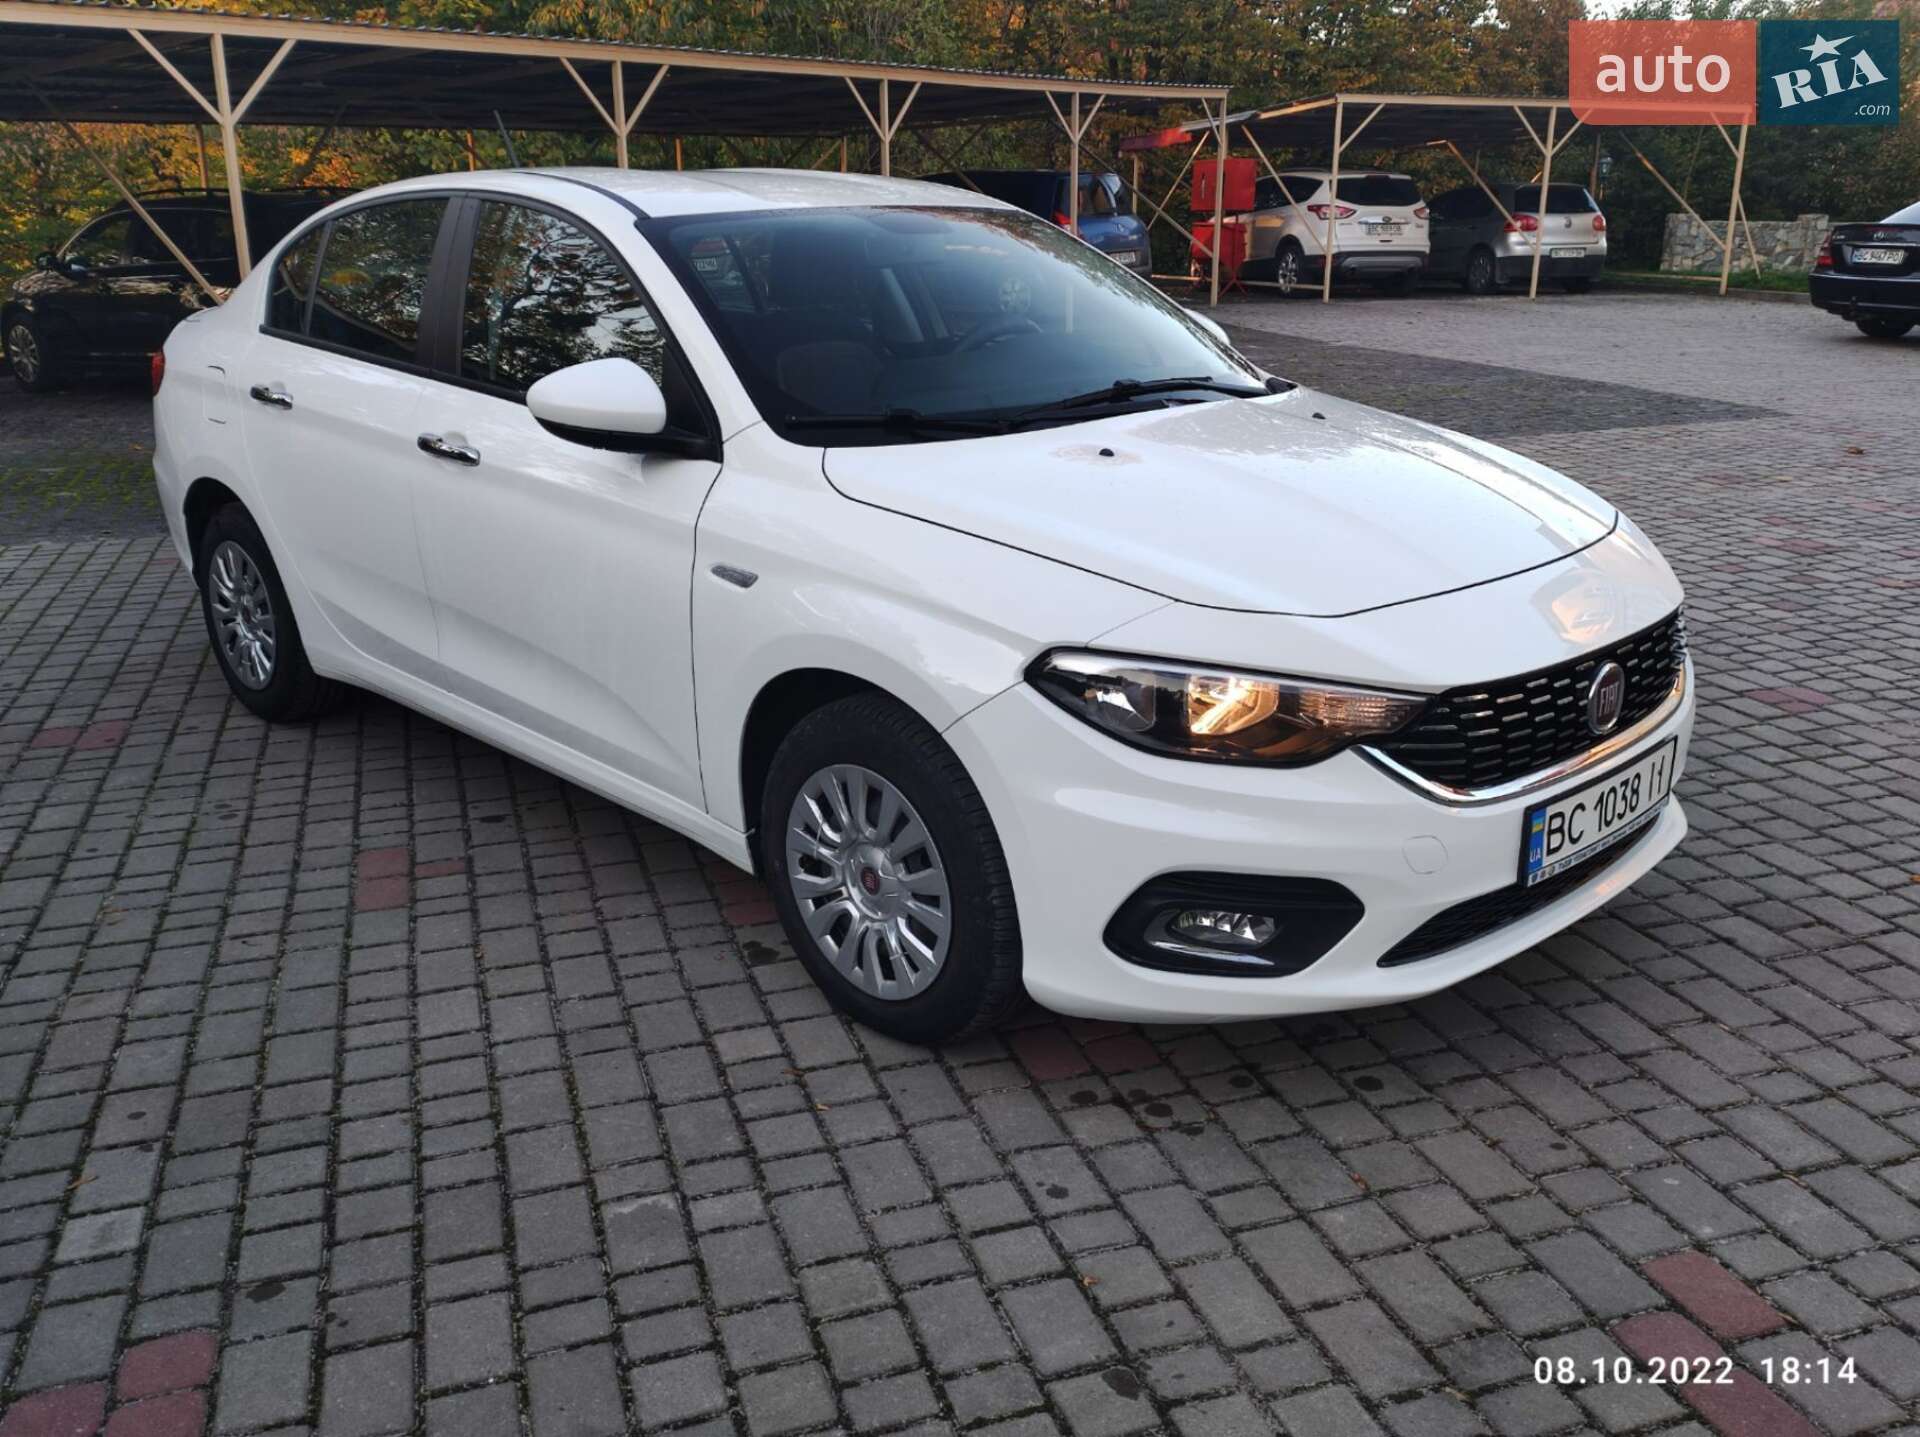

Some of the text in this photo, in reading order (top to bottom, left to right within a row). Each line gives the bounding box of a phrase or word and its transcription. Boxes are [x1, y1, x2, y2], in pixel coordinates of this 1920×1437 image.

[1599, 680, 1620, 718] FIAT
[1546, 802, 1586, 857] BC
[1593, 772, 1641, 832] 1038
[1529, 848, 1541, 863] UA
